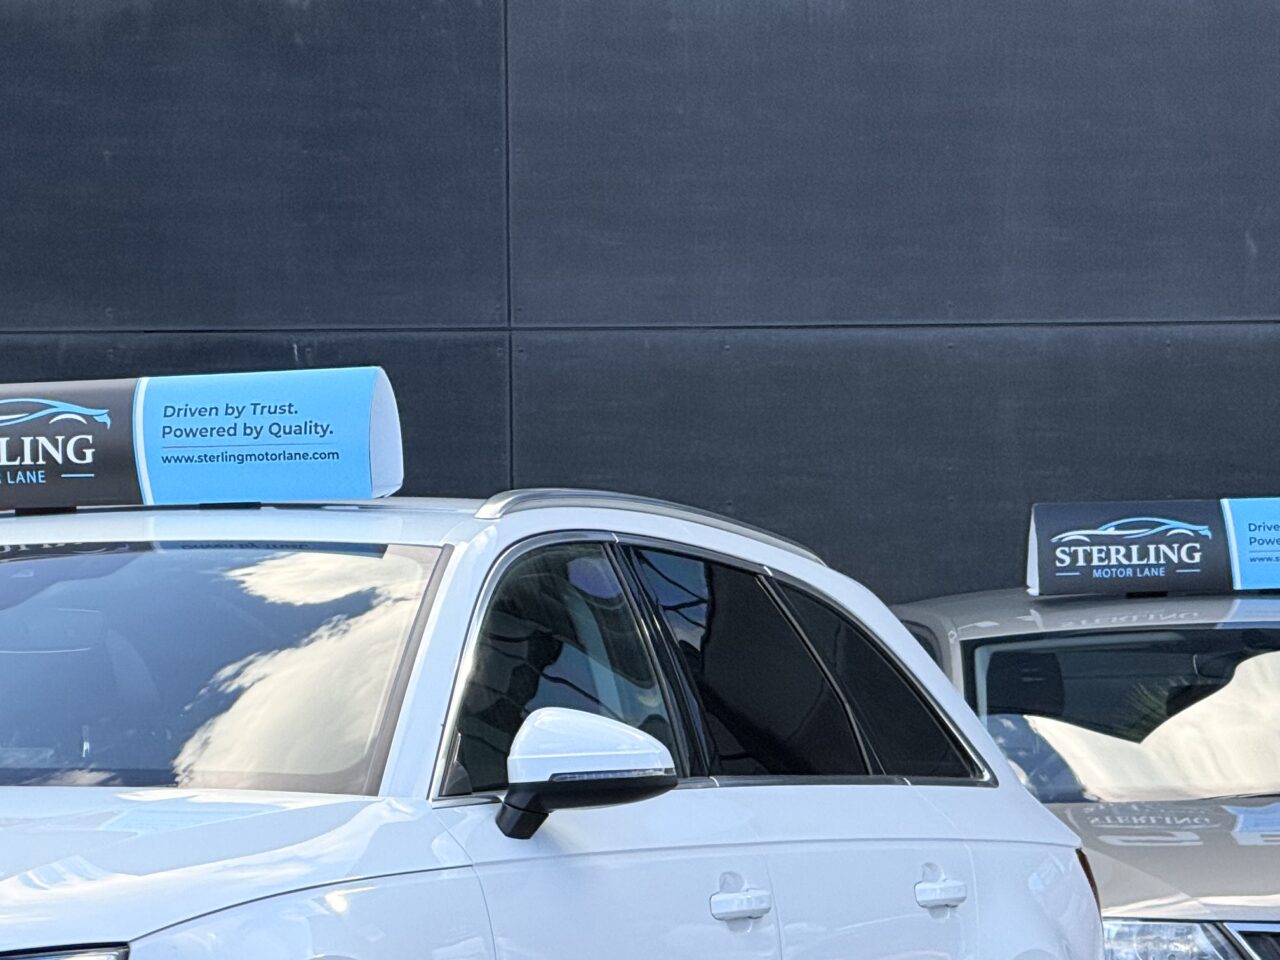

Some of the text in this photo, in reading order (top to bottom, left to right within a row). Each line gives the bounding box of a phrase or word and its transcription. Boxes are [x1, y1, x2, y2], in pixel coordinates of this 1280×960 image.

[163, 402, 298, 419] Driven by Trust.
[162, 421, 334, 440] Powered by Quality.
[161, 450, 340, 465] www.sterlingmotorlane.com
[7, 471, 46, 484] LANE
[1055, 542, 1202, 567] STERLING
[1092, 567, 1166, 579] MOTOR LANE
